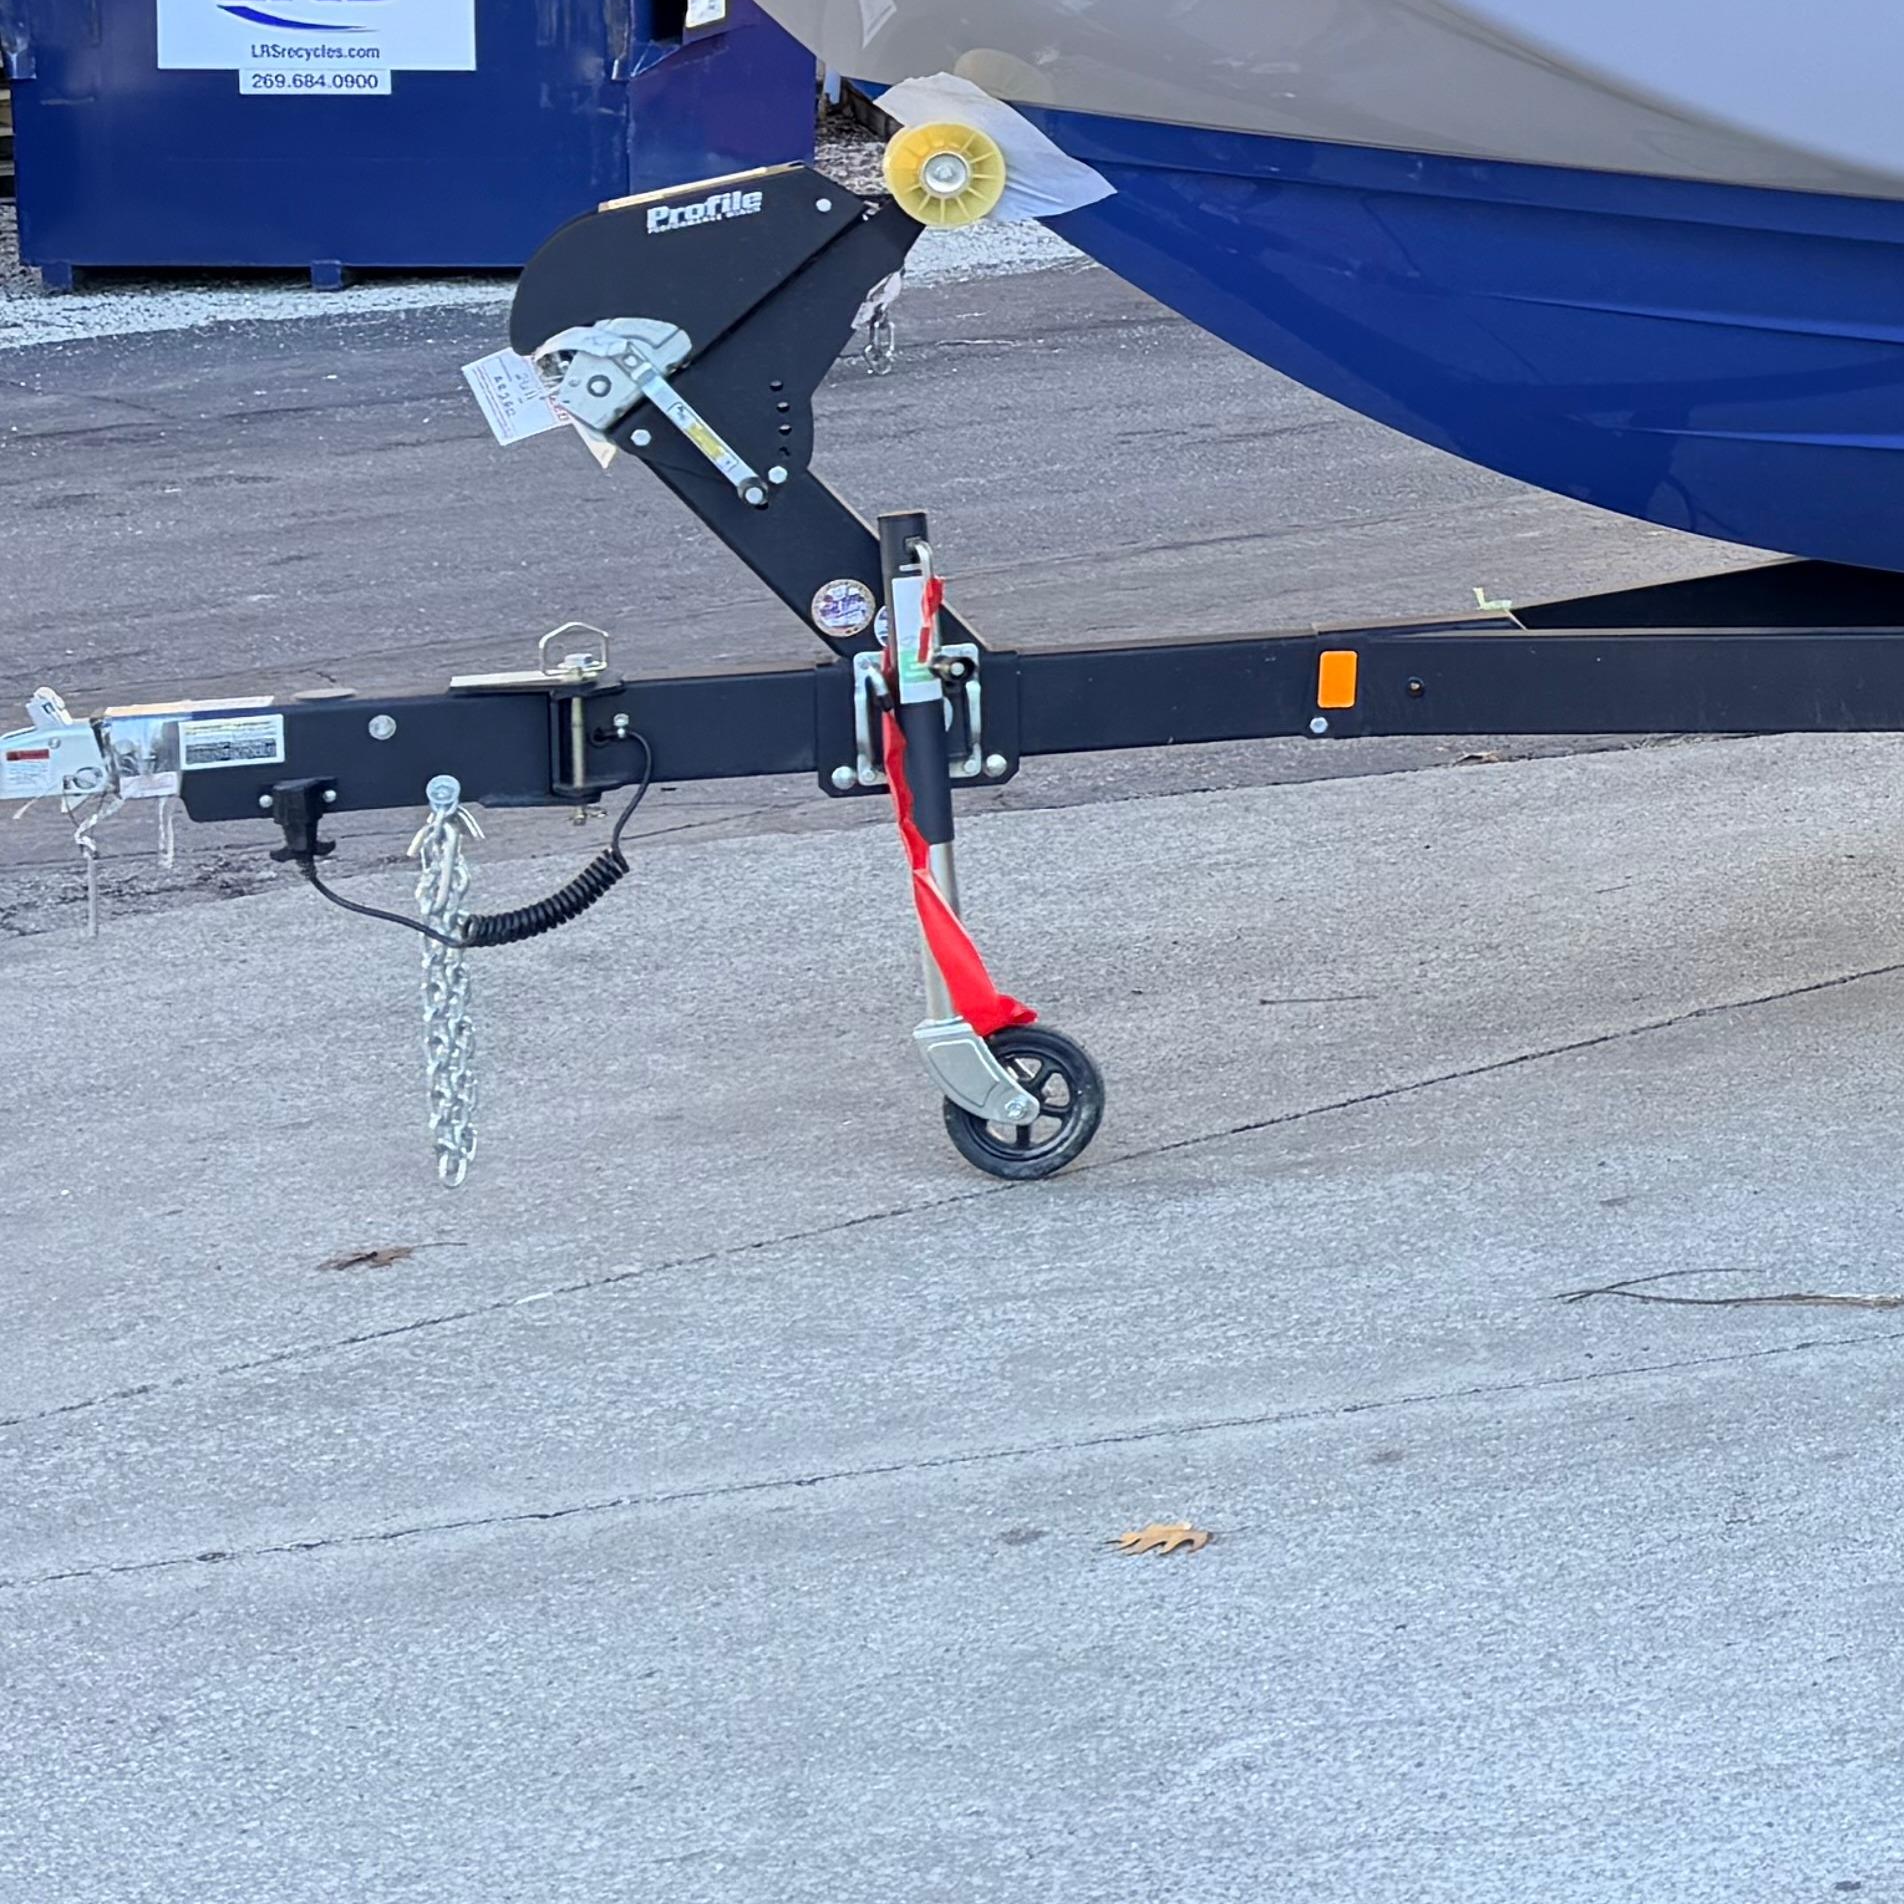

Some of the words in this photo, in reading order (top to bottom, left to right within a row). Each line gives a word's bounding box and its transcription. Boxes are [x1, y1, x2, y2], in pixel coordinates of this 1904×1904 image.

[251, 44, 380, 61] LRSrecycles.com
[252, 74, 379, 89] 269.684.0900
[646, 190, 763, 229] Profile
